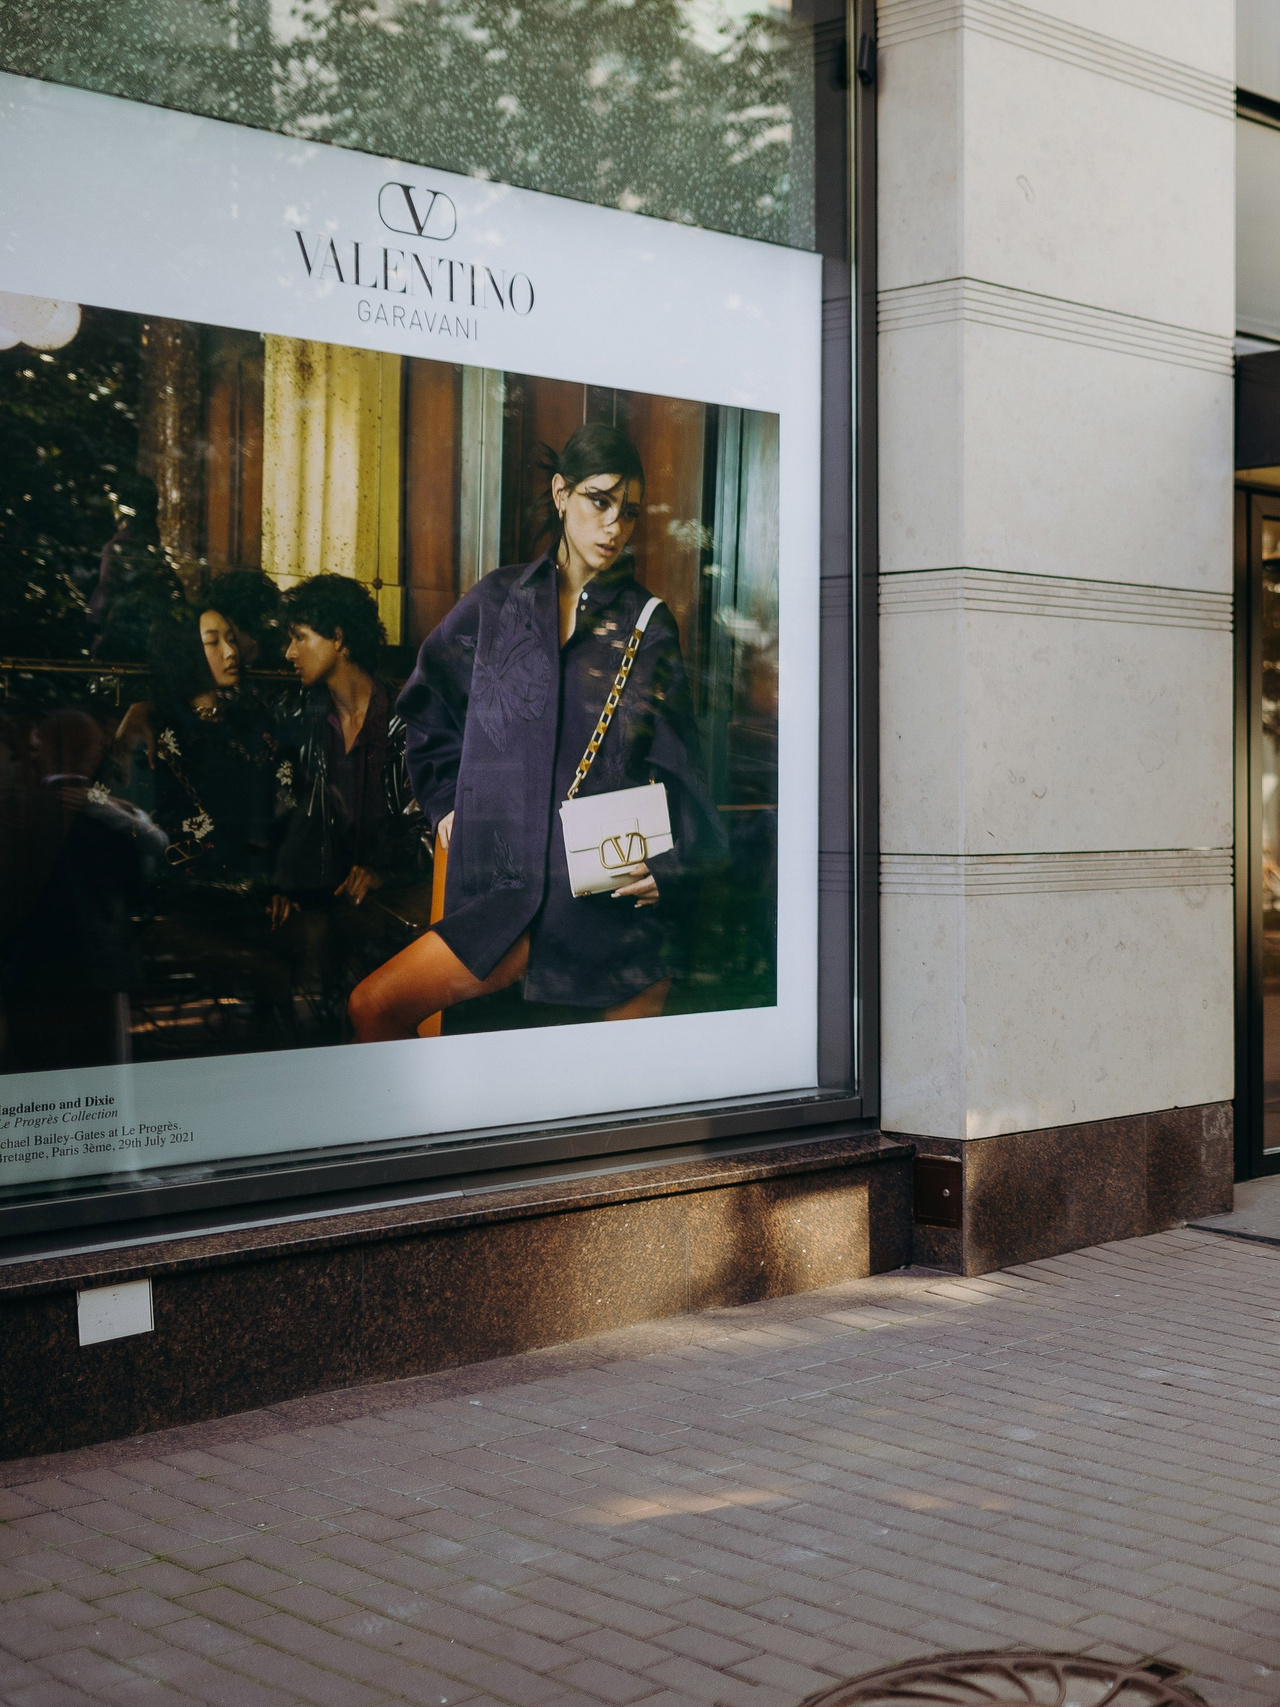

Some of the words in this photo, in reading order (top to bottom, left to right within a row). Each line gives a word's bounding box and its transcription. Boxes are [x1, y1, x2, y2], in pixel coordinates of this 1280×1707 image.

[294, 229, 535, 316] VALENTINO
[357, 300, 478, 340] GARAVANI
[59, 1097, 81, 1110] and
[85, 1095, 115, 1107] Dixie
[14, 1114, 59, 1129] Progrès
[62, 1109, 118, 1122] Collection
[0, 1136, 30, 1149] chael
[34, 1130, 105, 1145] Bailey-Gates
[109, 1128, 118, 1138] at
[121, 1126, 135, 1136] Le
[139, 1121, 181, 1135] Progrès.
[52, 1145, 79, 1157] Paris
[118, 1138, 141, 1149] 29th
[145, 1135, 166, 1147] July
[170, 1132, 194, 1144] 2021
